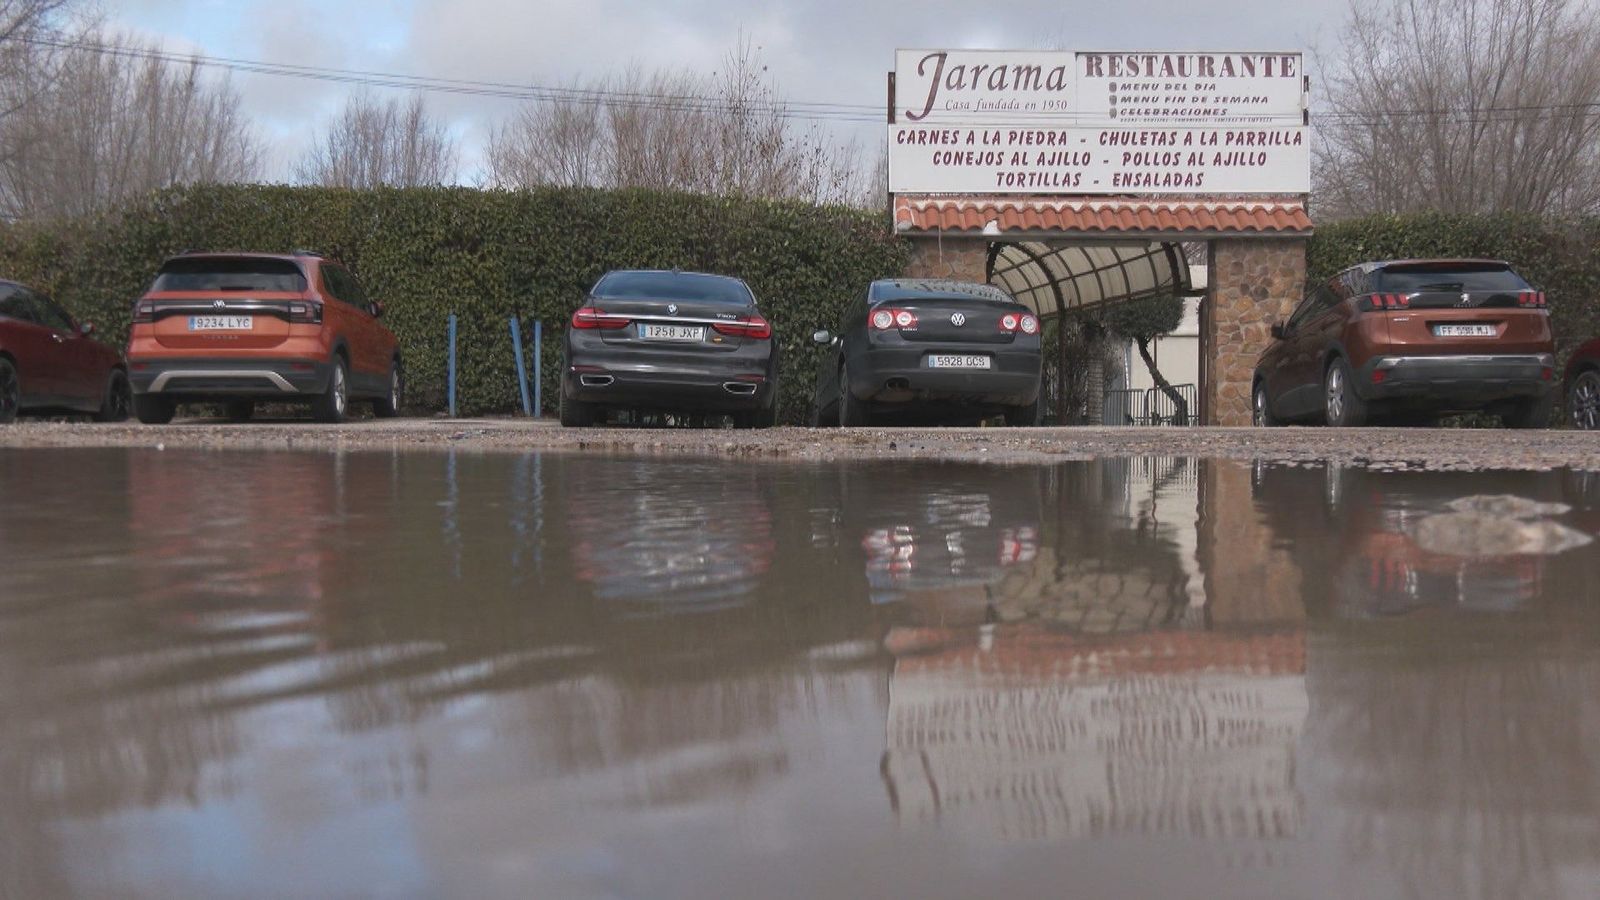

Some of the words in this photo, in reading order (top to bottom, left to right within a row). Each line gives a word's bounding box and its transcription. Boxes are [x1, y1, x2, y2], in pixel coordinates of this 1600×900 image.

[1084, 54, 1296, 77] RESTAURANTE
[906, 53, 1067, 121] Jarama
[1120, 83, 1159, 91] MENU
[1165, 83, 1187, 91] DEL
[1195, 83, 1216, 91] DIA
[945, 99, 970, 111] Casa
[973, 98, 1019, 112] fundada
[1025, 102, 1036, 110] en
[1042, 100, 1067, 111] 1950
[1120, 96, 1159, 104] MENU
[1165, 96, 1185, 104] FIN
[1192, 96, 1207, 104] DE
[1214, 96, 1268, 104] SEMANA
[1120, 107, 1228, 116] CELEBRACIONES
[897, 130, 959, 146] CARNES
[966, 130, 975, 146] A
[982, 130, 1001, 146] LA
[1009, 131, 1067, 146] PIEDRA
[1099, 130, 1178, 147] CHULETAS
[1183, 131, 1194, 147] A
[1200, 131, 1218, 147] LA
[1226, 131, 1302, 147] PARRILLA
[933, 151, 1004, 167] CONEJOS
[1011, 151, 1029, 166] AL
[1037, 151, 1091, 166] AJILLO
[1122, 152, 1181, 167] POLLOS
[1188, 152, 1205, 167] AL
[1213, 152, 1267, 167] AJILLO
[997, 172, 1081, 188] TORTILLAS
[1113, 172, 1204, 188] ENSALADAS
[197, 318, 224, 328] 9234
[228, 318, 250, 328] LYC
[679, 327, 699, 338] JXP
[937, 356, 963, 366] 5928
